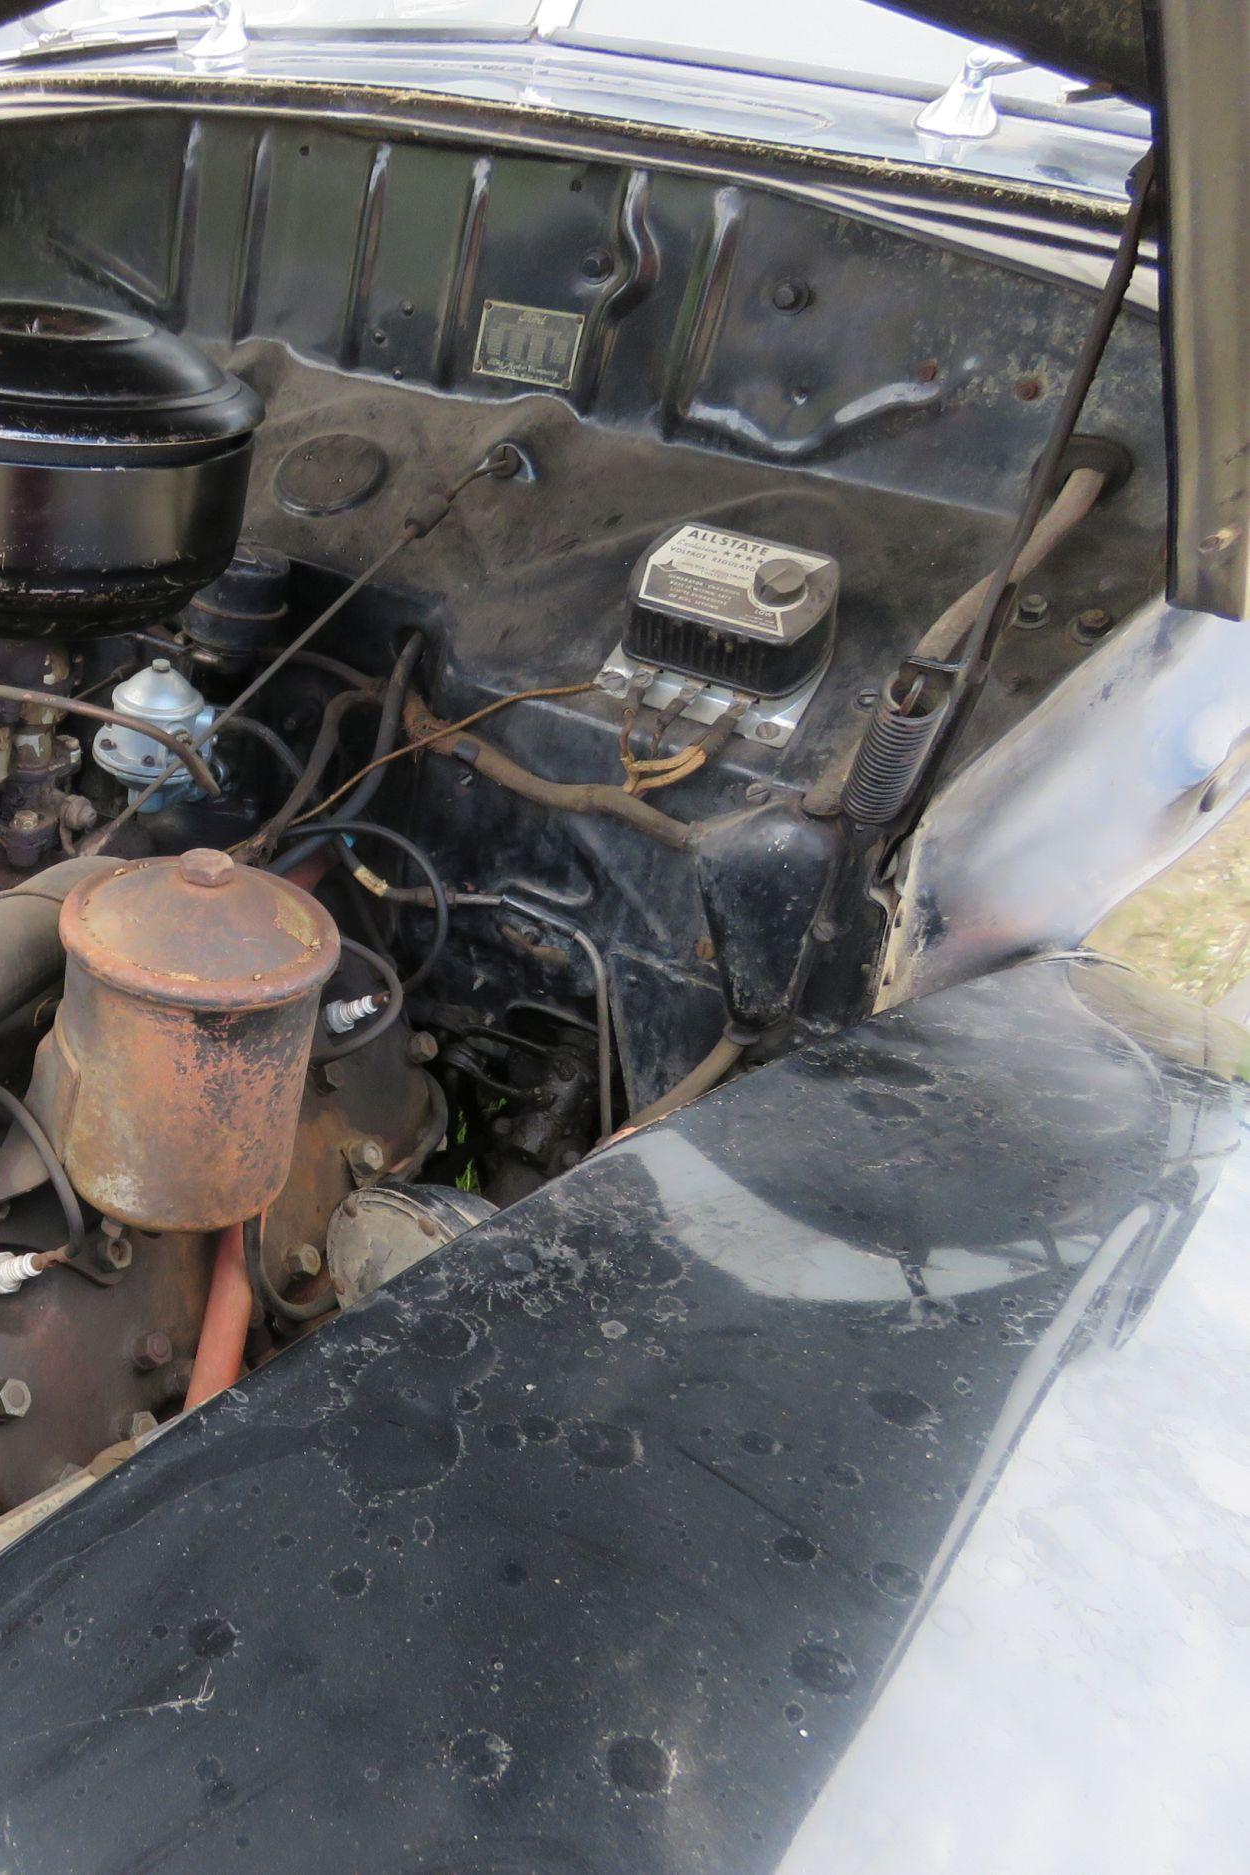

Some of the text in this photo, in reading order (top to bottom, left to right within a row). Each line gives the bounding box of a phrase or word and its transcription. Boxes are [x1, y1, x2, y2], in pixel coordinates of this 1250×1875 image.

[518, 311, 549, 325] Ford
[688, 530, 770, 556] ALLSTATE
[669, 546, 707, 560] VOLTAGE
[711, 558, 757, 573] REGULATO
[754, 608, 774, 618] LOW
